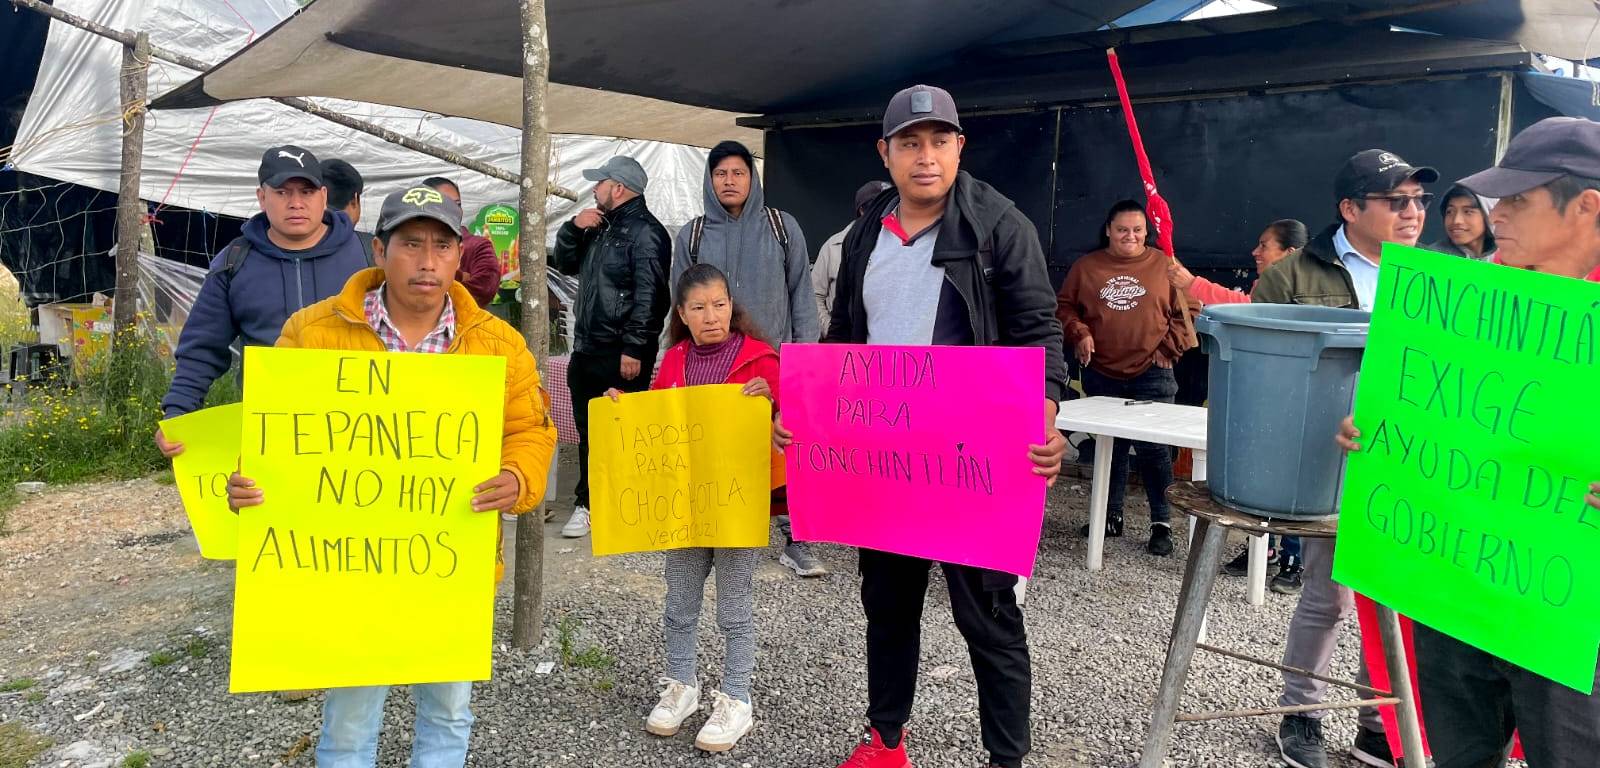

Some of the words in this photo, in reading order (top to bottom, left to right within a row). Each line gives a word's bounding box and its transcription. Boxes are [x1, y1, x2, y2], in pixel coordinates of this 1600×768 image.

[336, 357, 391, 395] EN
[839, 351, 937, 389] AYUDA
[1399, 346, 1542, 444] EXIGE
[252, 410, 479, 463] TEPANECA
[836, 397, 911, 431] PARA
[635, 452, 688, 474] PARA
[791, 442, 993, 495] TONCHINTLÁN
[1366, 418, 1501, 501] AYUDA
[317, 466, 383, 507] NO
[399, 474, 455, 516] HAY
[619, 477, 746, 526] CHOCHOTLA
[252, 527, 458, 578] ALIMENTOS
[1366, 483, 1573, 608] GOBIERNO
